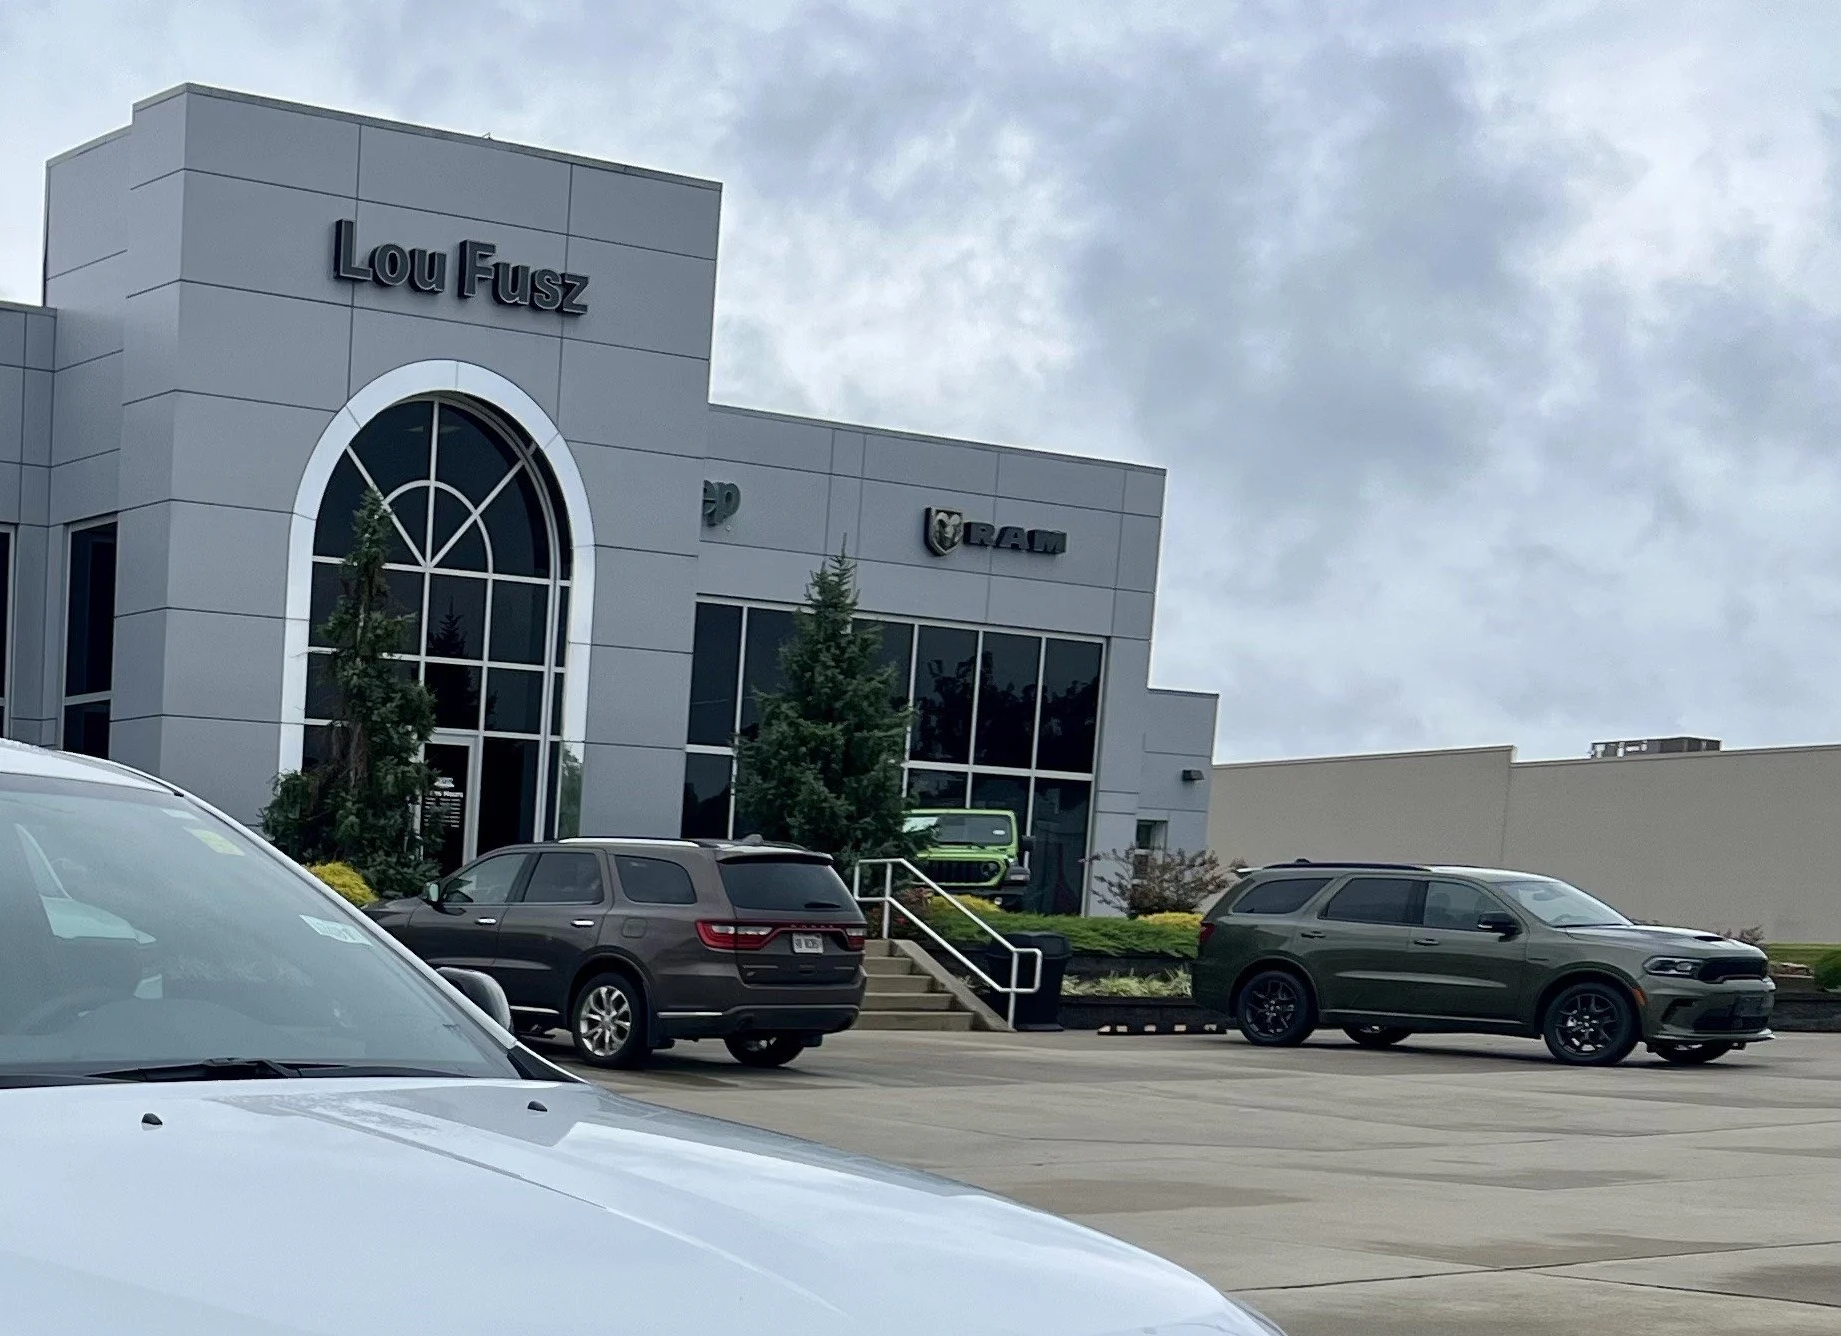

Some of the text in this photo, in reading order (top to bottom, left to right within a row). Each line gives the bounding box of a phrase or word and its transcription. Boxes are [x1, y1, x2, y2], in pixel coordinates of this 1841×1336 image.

[334, 218, 590, 314] Lou Fusz
[963, 521, 1067, 555] RAM
